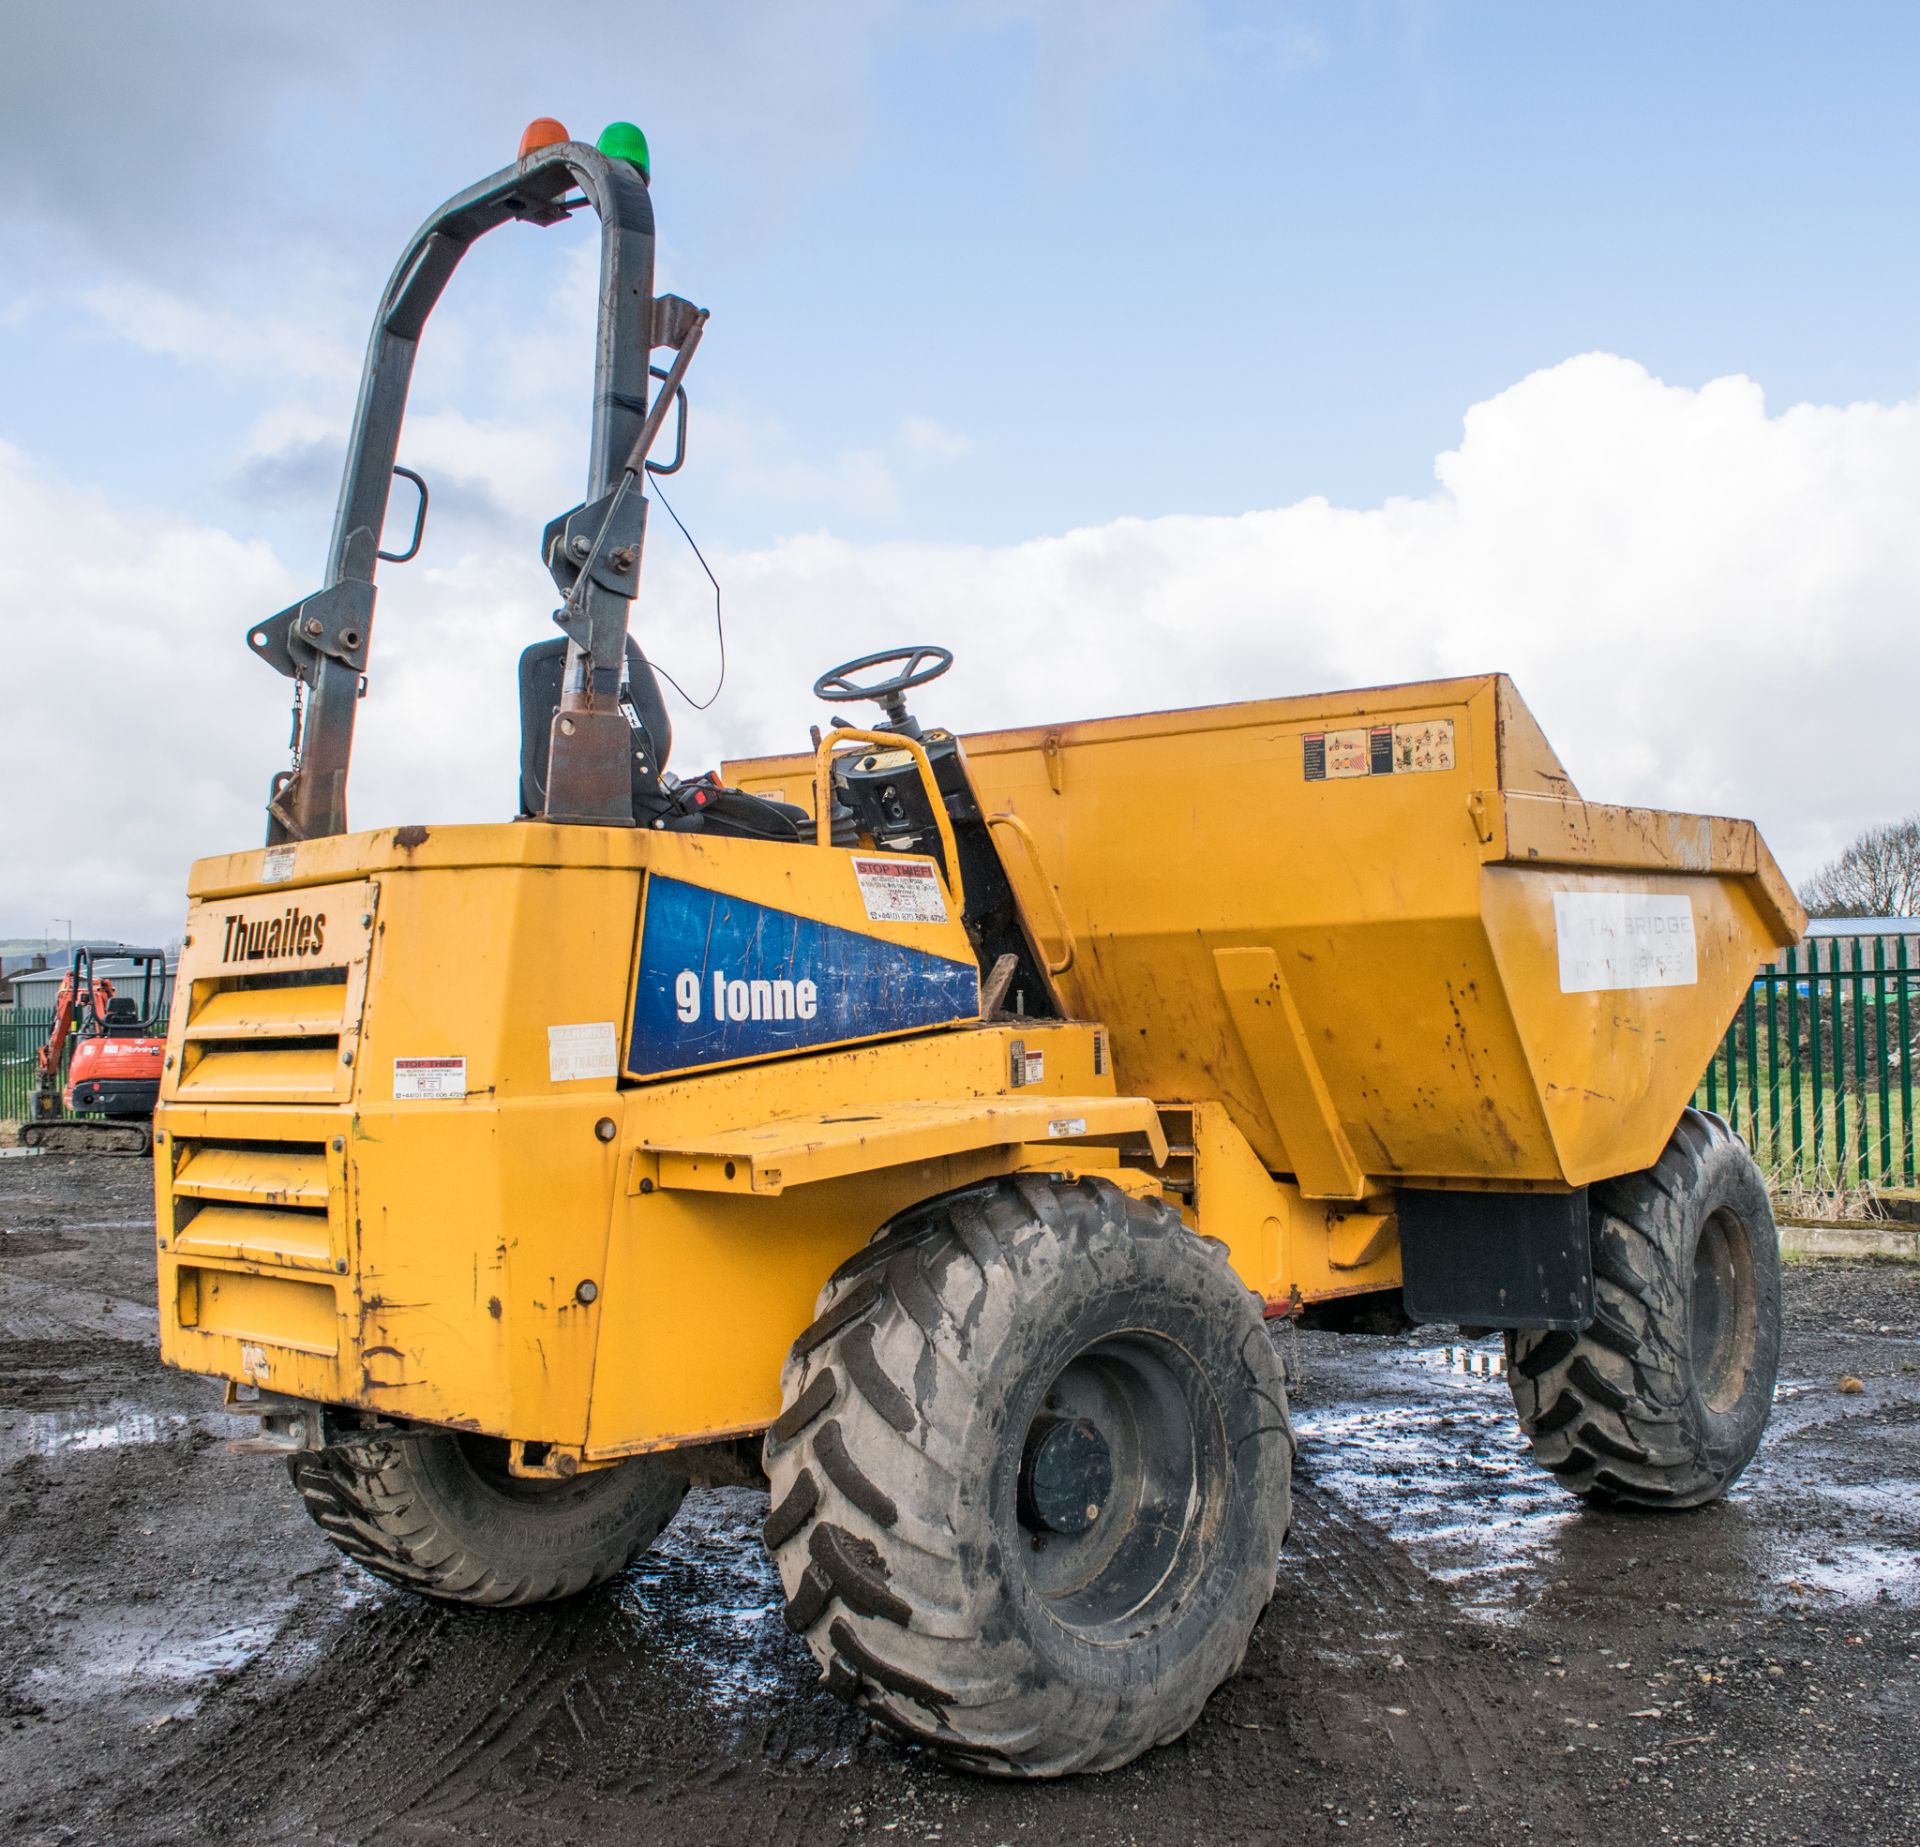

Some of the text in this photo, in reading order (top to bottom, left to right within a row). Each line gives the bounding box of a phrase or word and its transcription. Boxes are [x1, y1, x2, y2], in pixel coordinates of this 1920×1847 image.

[858, 863, 890, 875] STOP
[222, 907, 327, 963] Thwaites
[675, 970, 818, 1024] 9 tonne
[396, 1060, 425, 1069] STOP
